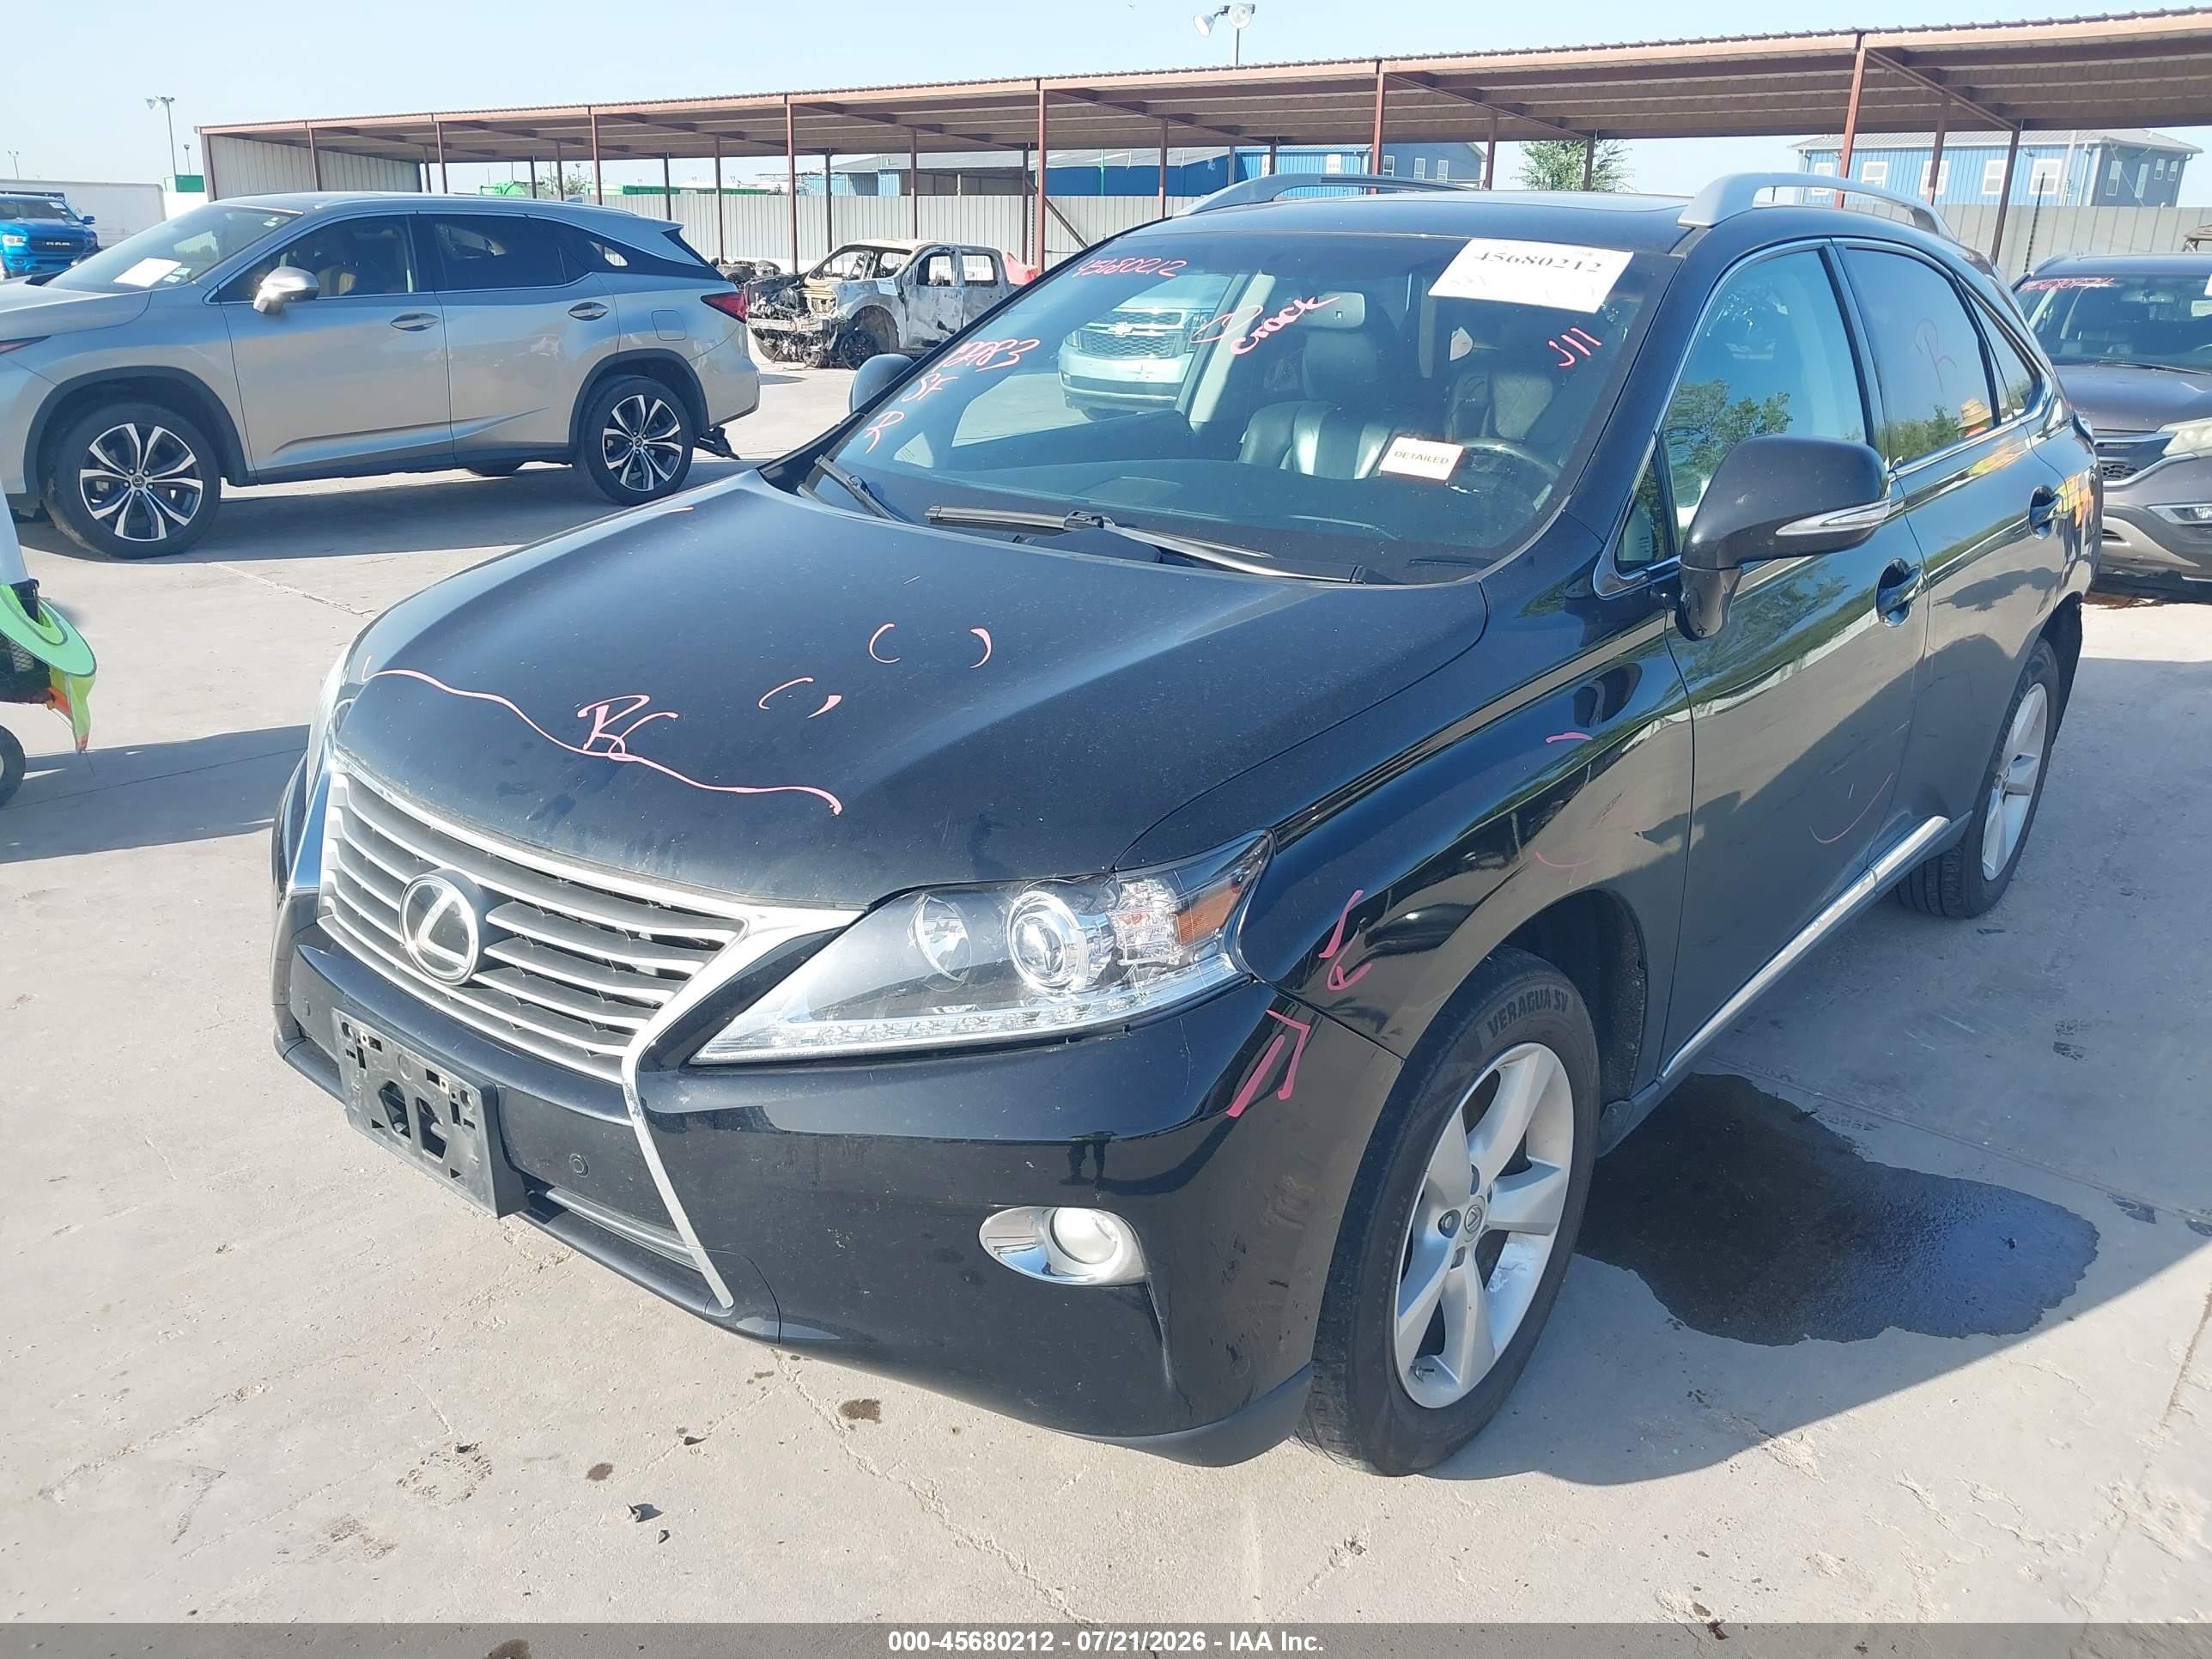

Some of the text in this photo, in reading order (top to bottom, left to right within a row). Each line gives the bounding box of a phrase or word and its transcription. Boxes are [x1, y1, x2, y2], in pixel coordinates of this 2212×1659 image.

[1474, 250, 1602, 273] 45680212
[1393, 450, 1450, 465] DETAILED
[1486, 988, 1569, 1038] VERAGUA SV
